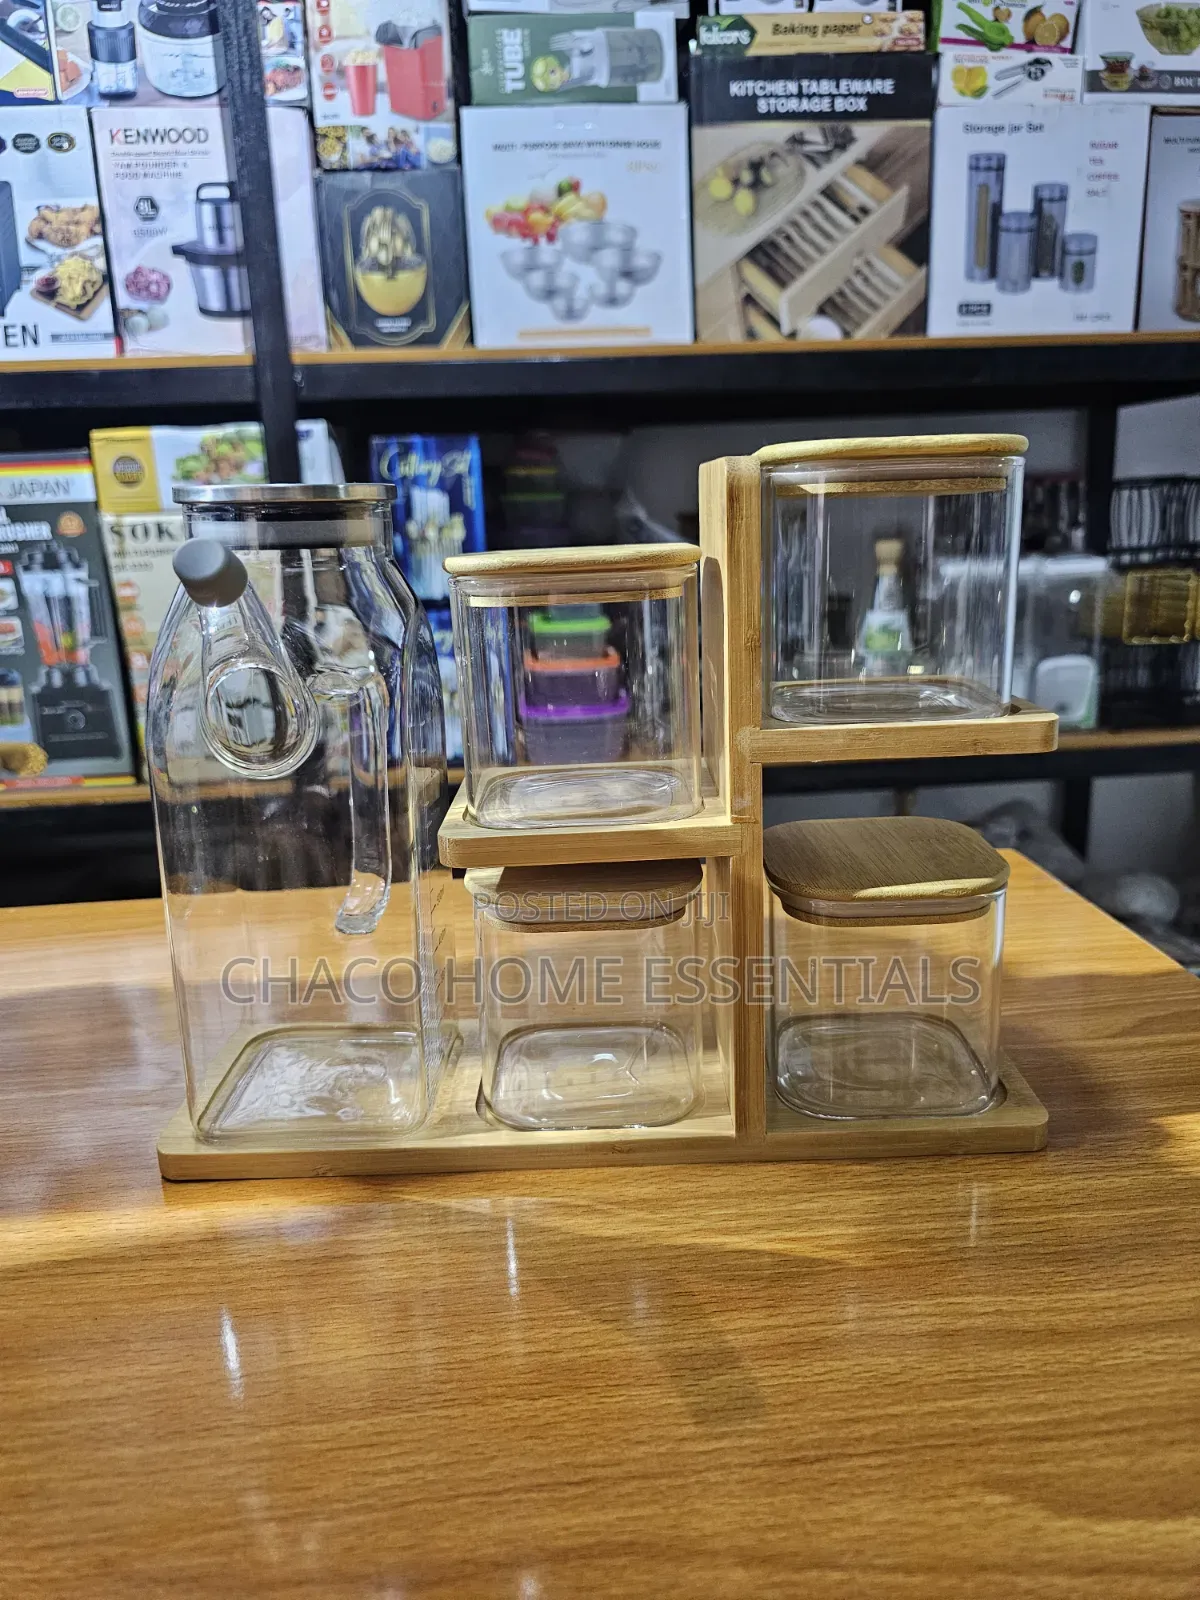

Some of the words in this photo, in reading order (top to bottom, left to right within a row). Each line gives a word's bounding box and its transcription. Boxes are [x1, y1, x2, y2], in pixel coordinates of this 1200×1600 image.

[772, 23, 819, 37] Baking
[821, 24, 861, 37] paper
[501, 27, 526, 94] TUBE
[729, 79, 799, 97] KITCHEN
[800, 78, 896, 95] TABLEWARE
[757, 97, 832, 113] STORAGE
[834, 96, 869, 112] BOX
[109, 127, 210, 145] KENWOOD
[8, 479, 71, 499] JAPAN
